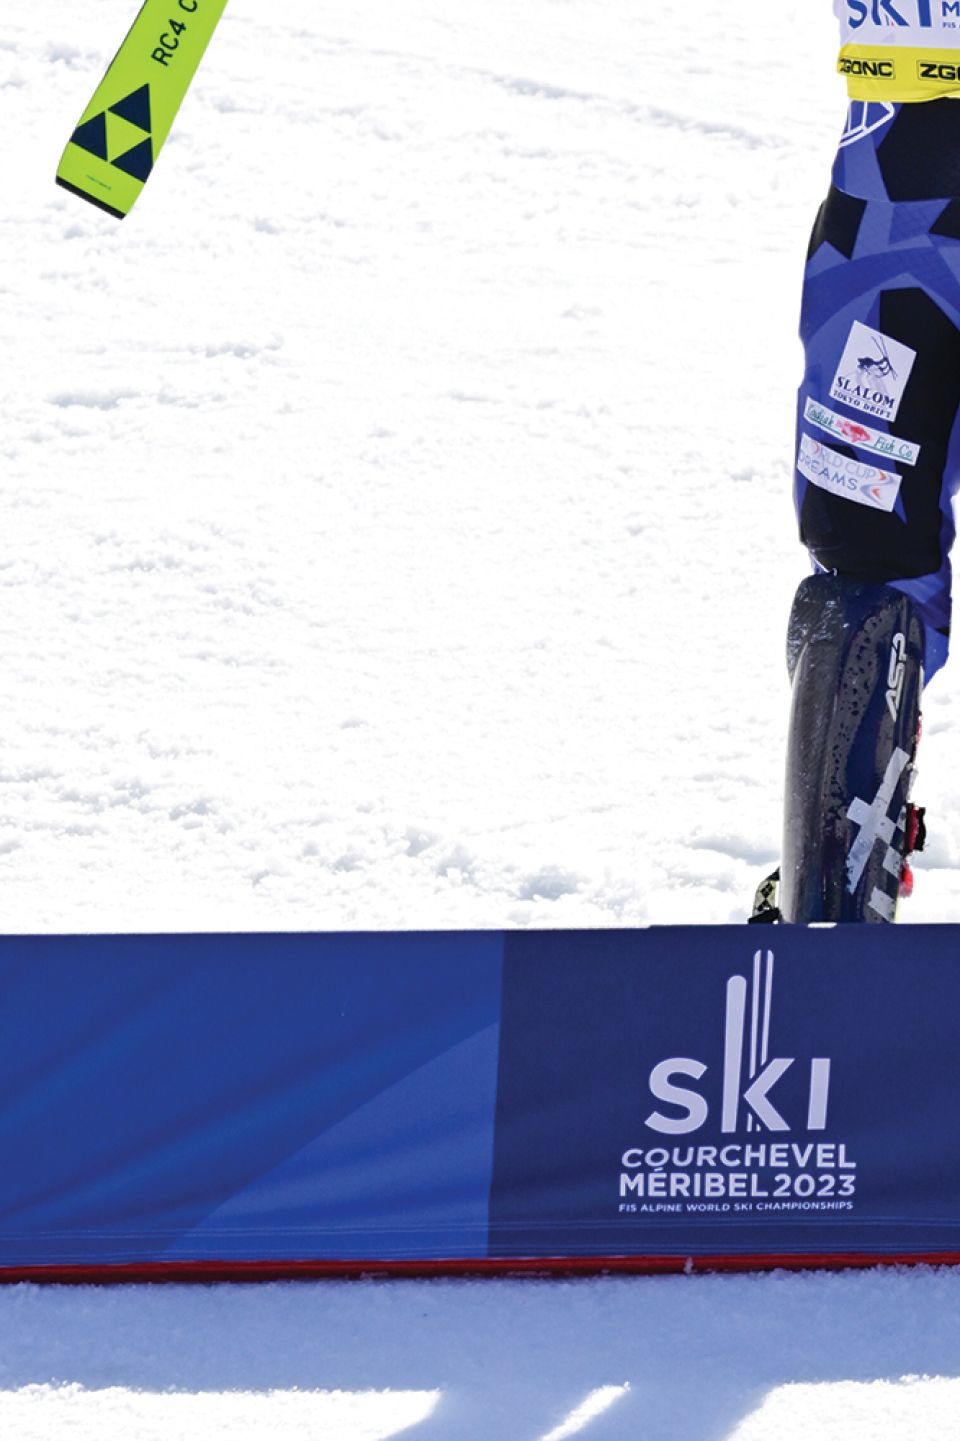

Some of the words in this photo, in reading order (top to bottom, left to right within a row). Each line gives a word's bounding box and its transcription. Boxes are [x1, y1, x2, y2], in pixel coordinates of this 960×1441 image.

[151, 18, 187, 66] RC4
[837, 376, 895, 409] SLALOM
[798, 450, 859, 491] DREAMS
[845, 461, 877, 479] CUP
[621, 1143, 857, 1168] COURCHEVEL
[619, 1166, 769, 1197] MÉRIBEL
[772, 1172, 857, 1197] 2023
[618, 1203, 637, 1213] FIS
[640, 1203, 682, 1213] ALPINE
[686, 1202, 731, 1213] WORLD
[734, 1202, 753, 1212] SKI
[755, 1201, 854, 1211] CHAMPIONSHIPS
